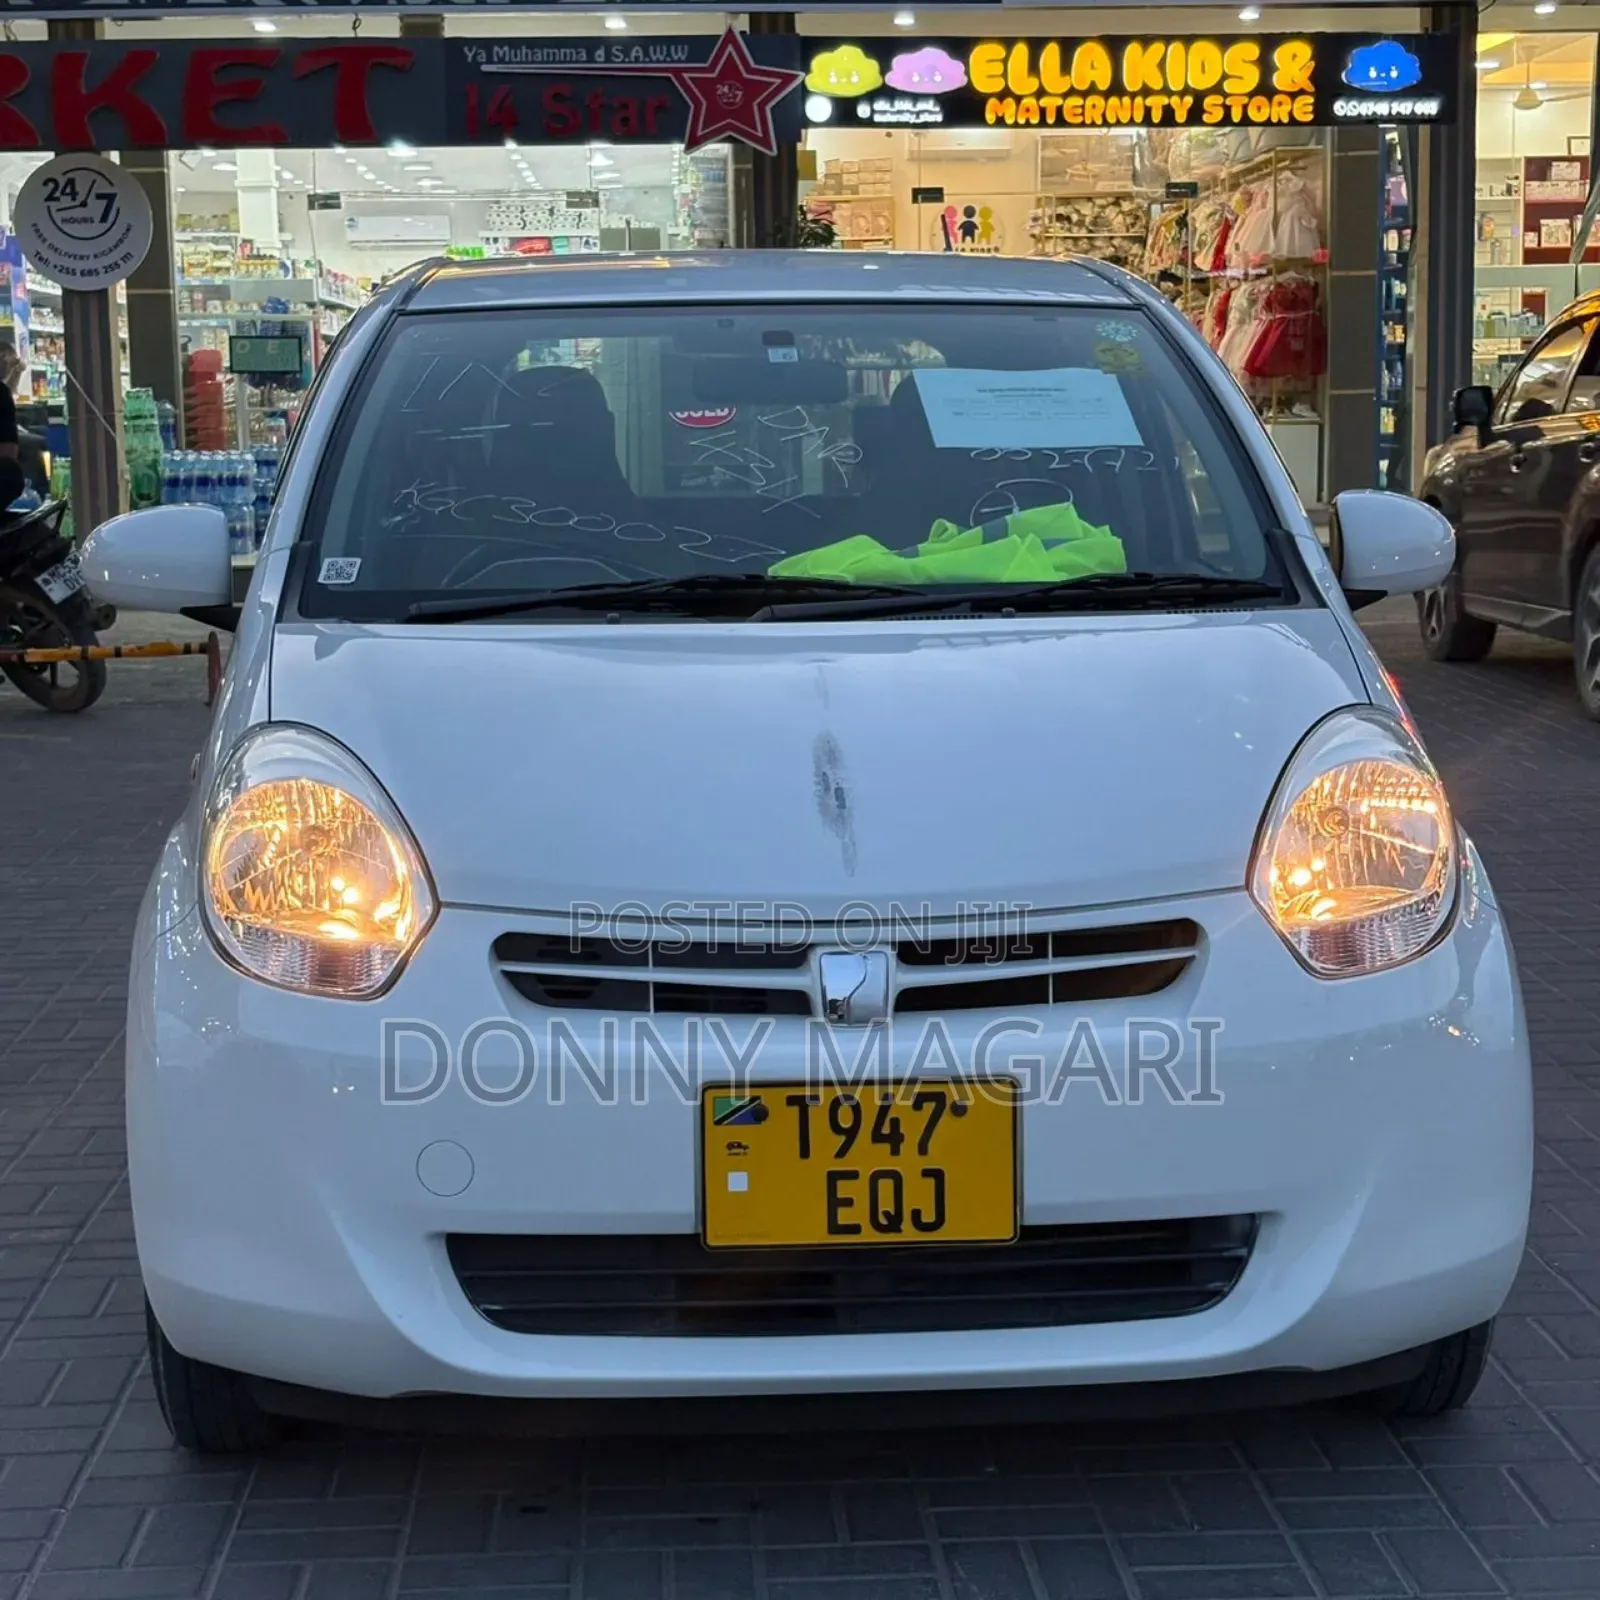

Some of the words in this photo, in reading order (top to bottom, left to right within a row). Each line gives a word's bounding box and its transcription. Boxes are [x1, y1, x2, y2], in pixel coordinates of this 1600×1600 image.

[464, 46, 487, 62] Ya
[492, 46, 587, 62] Muhamma
[594, 46, 605, 62] d
[611, 45, 688, 62] S.A.W.W
[969, 41, 1112, 95] ELLA
[1123, 41, 1260, 94] KIDS
[1273, 41, 1315, 93] &
[465, 82, 519, 138] 14
[541, 82, 672, 137] Star
[985, 95, 1193, 125] MATERNITY
[1202, 94, 1315, 124] STORE
[61, 216, 95, 225] HOURS
[47, 242, 91, 260] DELIVERY
[102, 260, 121, 275] 255
[785, 1091, 947, 1160] T947
[826, 1167, 946, 1236] EQJ
